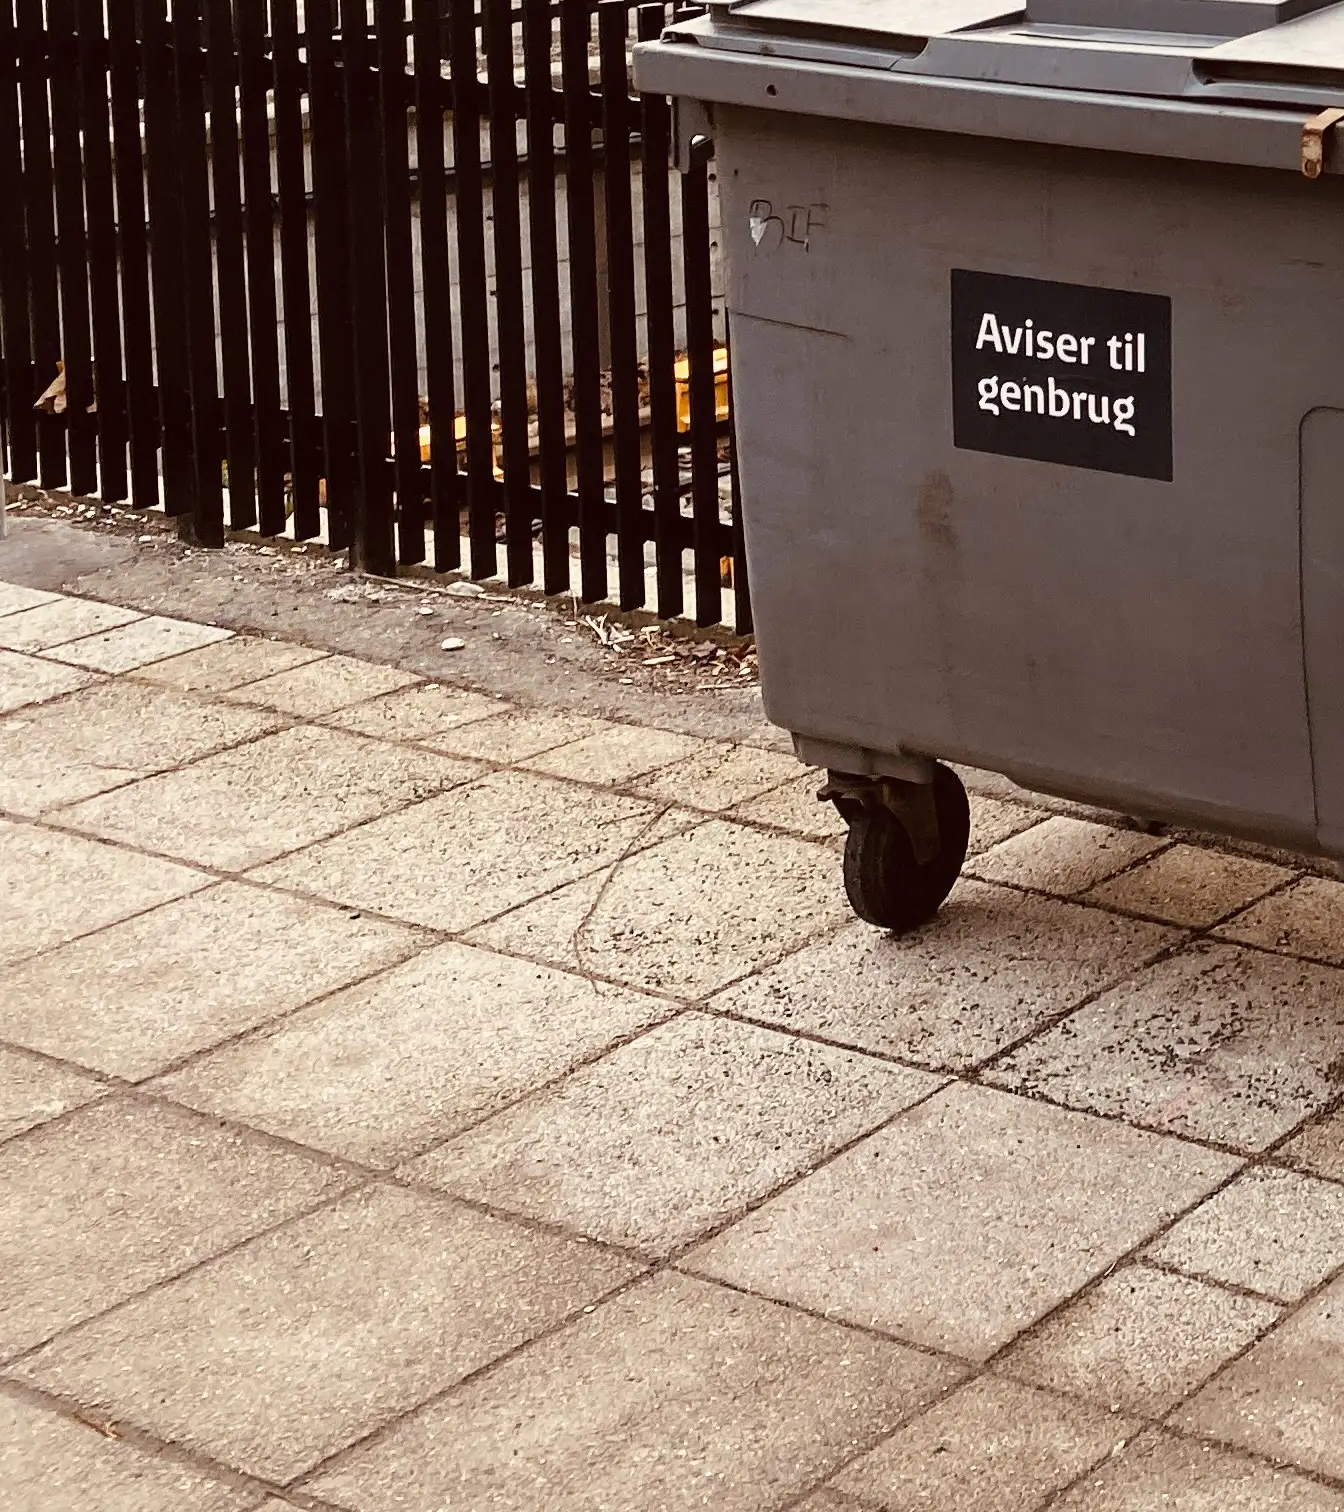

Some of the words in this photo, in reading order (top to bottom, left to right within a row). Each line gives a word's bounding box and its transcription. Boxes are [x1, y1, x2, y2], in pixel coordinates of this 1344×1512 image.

[975, 312, 1095, 365] Aviser
[1106, 333, 1146, 373] til
[976, 375, 1136, 437] genbrug
